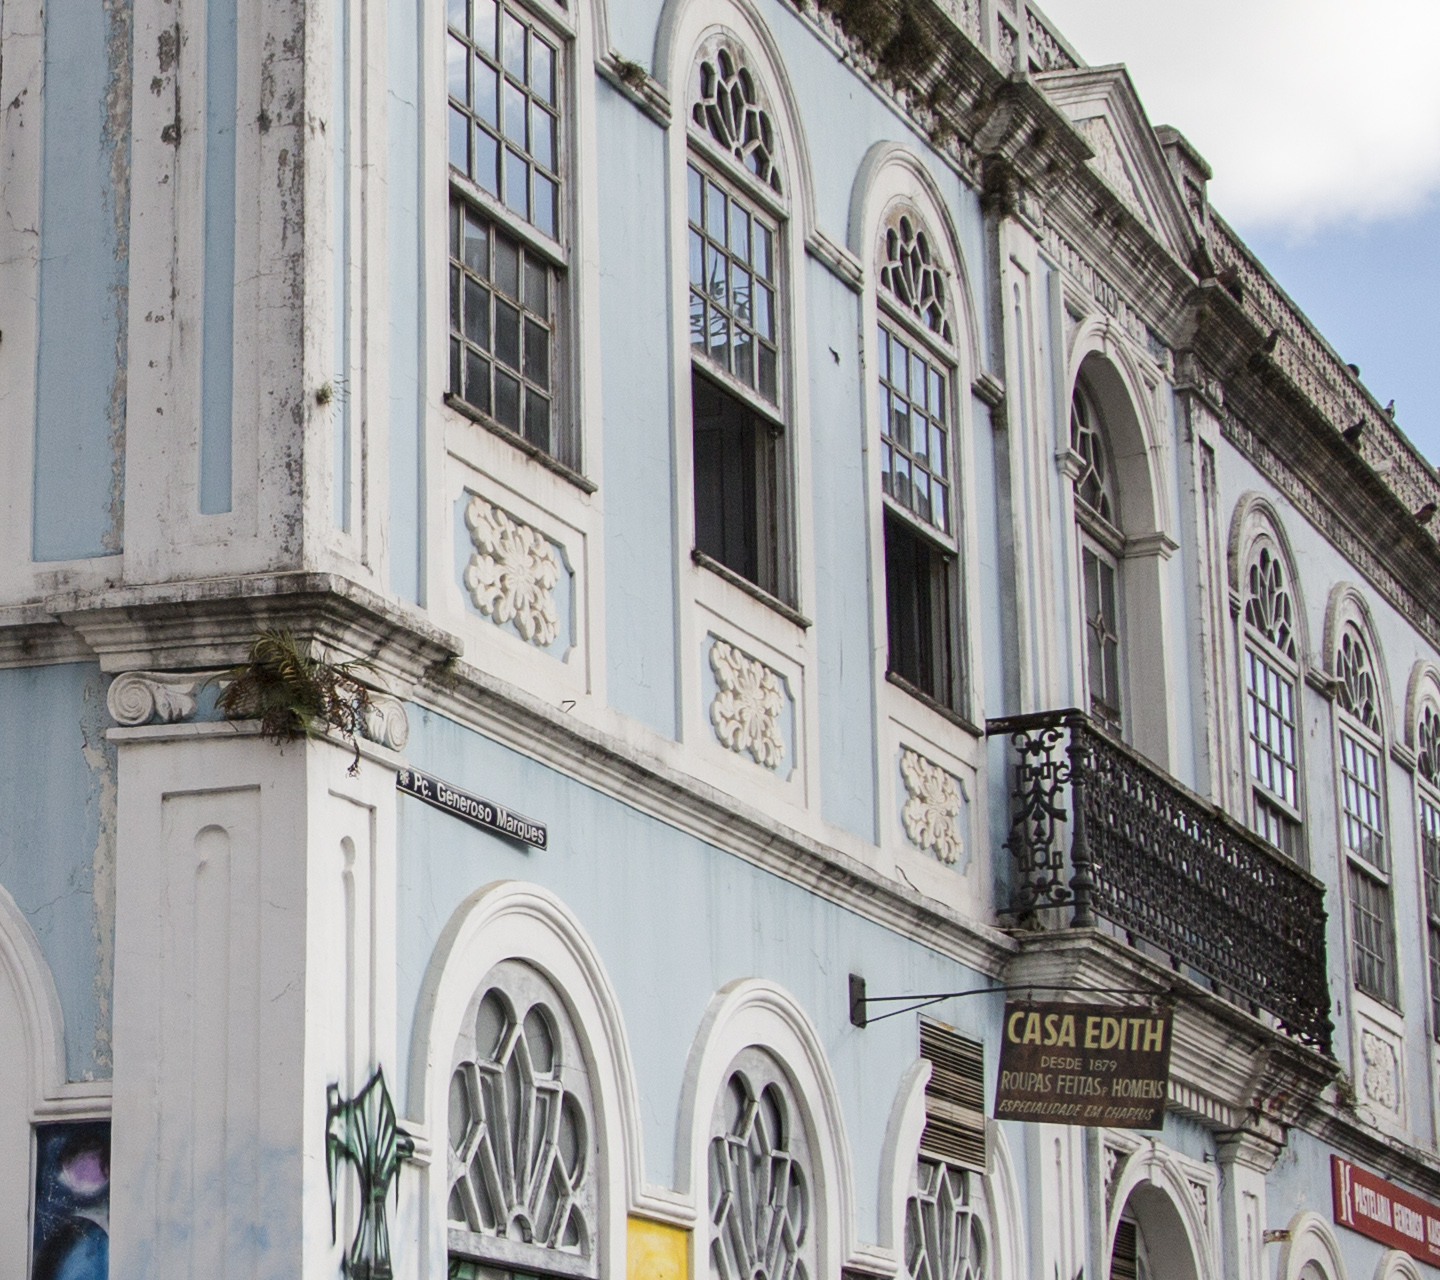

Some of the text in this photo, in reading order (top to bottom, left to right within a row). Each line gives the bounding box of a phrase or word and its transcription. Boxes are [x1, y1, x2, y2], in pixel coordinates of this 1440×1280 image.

[436, 782, 493, 823] Generoso
[496, 807, 545, 844] Marques
[1007, 1011, 1165, 1053] CASA EDITH
[1040, 1055, 1118, 1072] DESDE 1879
[1000, 1070, 1053, 1093] ROUPAS
[1056, 1074, 1102, 1096] FEITAS
[1111, 1077, 1166, 1099] HOMENS
[998, 1098, 1082, 1117] ESPECIALIDADE
[1084, 1104, 1103, 1118] EM
